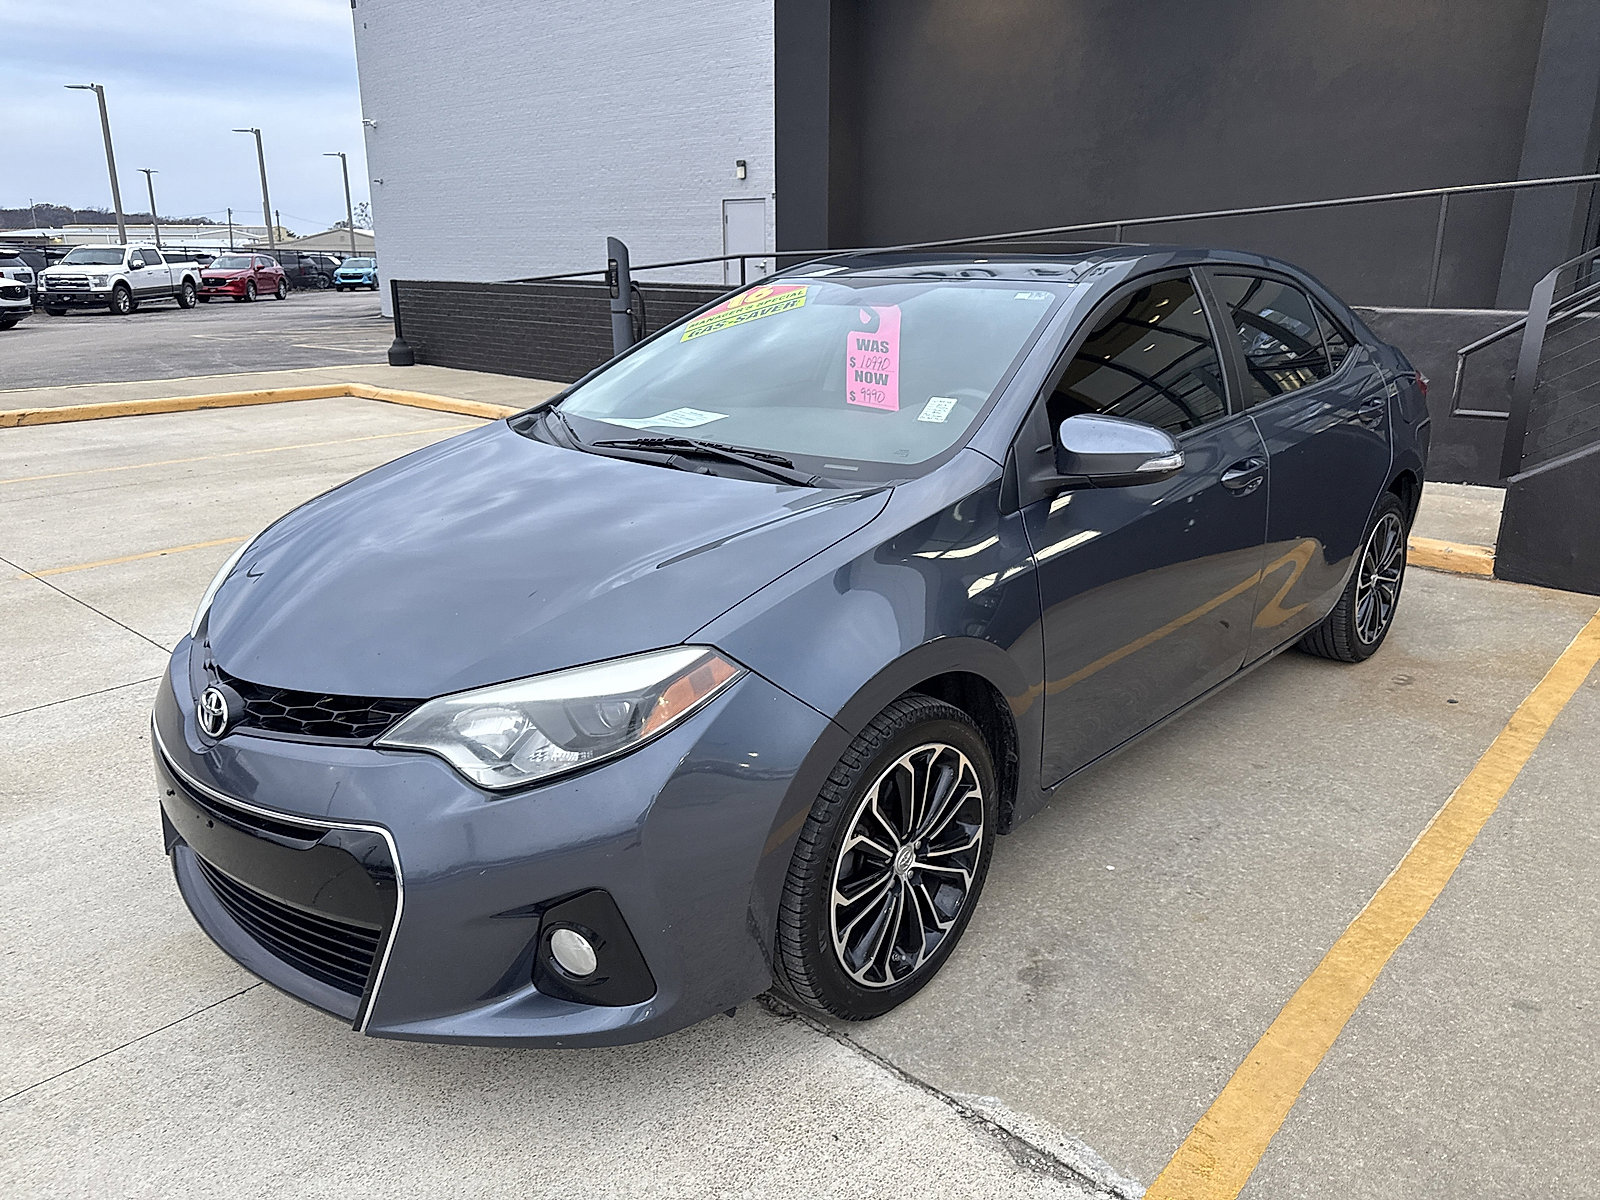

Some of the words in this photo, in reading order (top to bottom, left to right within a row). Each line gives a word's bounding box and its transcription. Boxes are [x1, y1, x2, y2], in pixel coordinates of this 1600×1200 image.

[757, 290, 804, 308] SPECIAL
[856, 338, 890, 354] WAS
[850, 356, 856, 368] $
[860, 355, 890, 371] 10990
[854, 369, 889, 386] NOW
[850, 390, 856, 402] $
[860, 387, 886, 404] 9990
